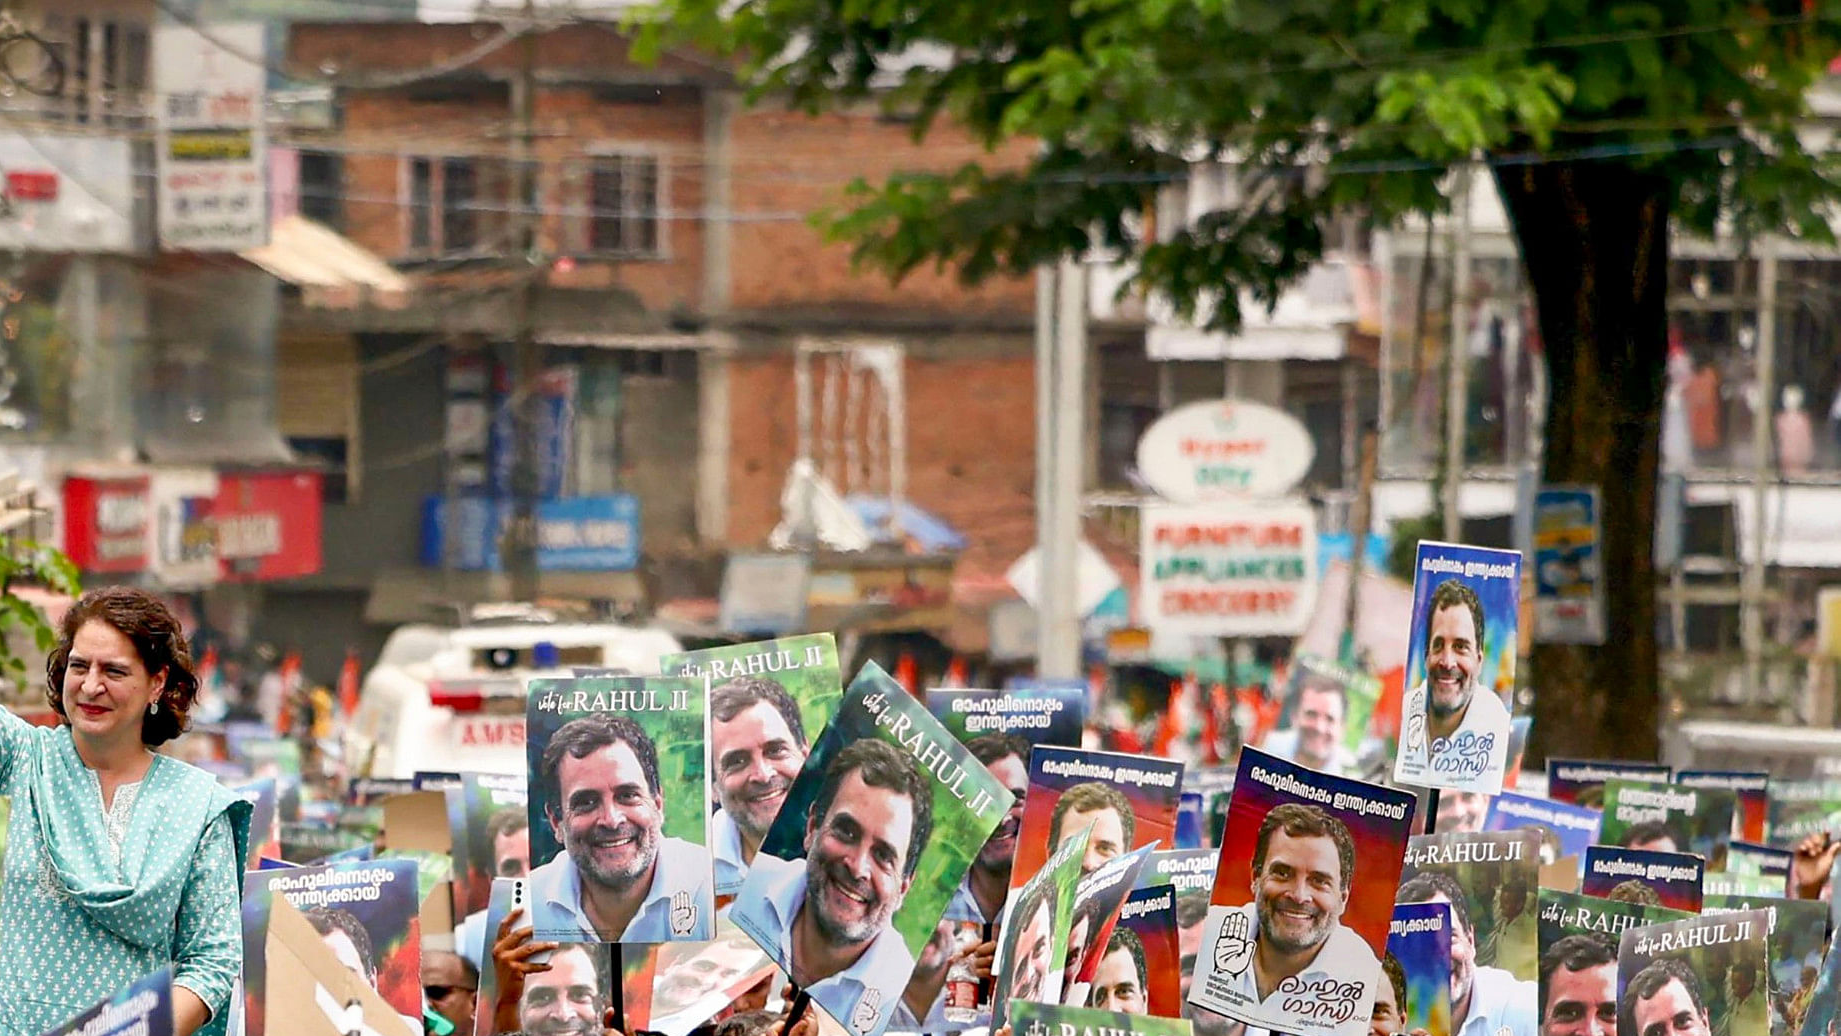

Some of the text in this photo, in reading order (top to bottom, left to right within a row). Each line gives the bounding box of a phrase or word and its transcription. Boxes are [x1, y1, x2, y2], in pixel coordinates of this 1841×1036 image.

[709, 650, 800, 679] RAHUL
[804, 646, 823, 668] JI
[538, 690, 689, 715] vote for RAHUL JI
[952, 693, 1064, 716] രാഹുലിനൊപ്പം
[965, 712, 1053, 733] ഇന്ത്യക്കായ്
[862, 692, 882, 715] vote
[889, 711, 970, 800] RAHUL
[965, 788, 994, 819] JI
[1250, 766, 1408, 821] രാഹുലിനൊപ്പം ഇന്ത്യക്കായ്
[1426, 841, 1501, 865] RAHUL
[1504, 841, 1522, 861] JI
[268, 867, 395, 892] രാഹുലിനൊപ്പം
[1541, 904, 1562, 924] vote
[1659, 926, 1732, 952] RAHUL
[1734, 920, 1752, 941] JI
